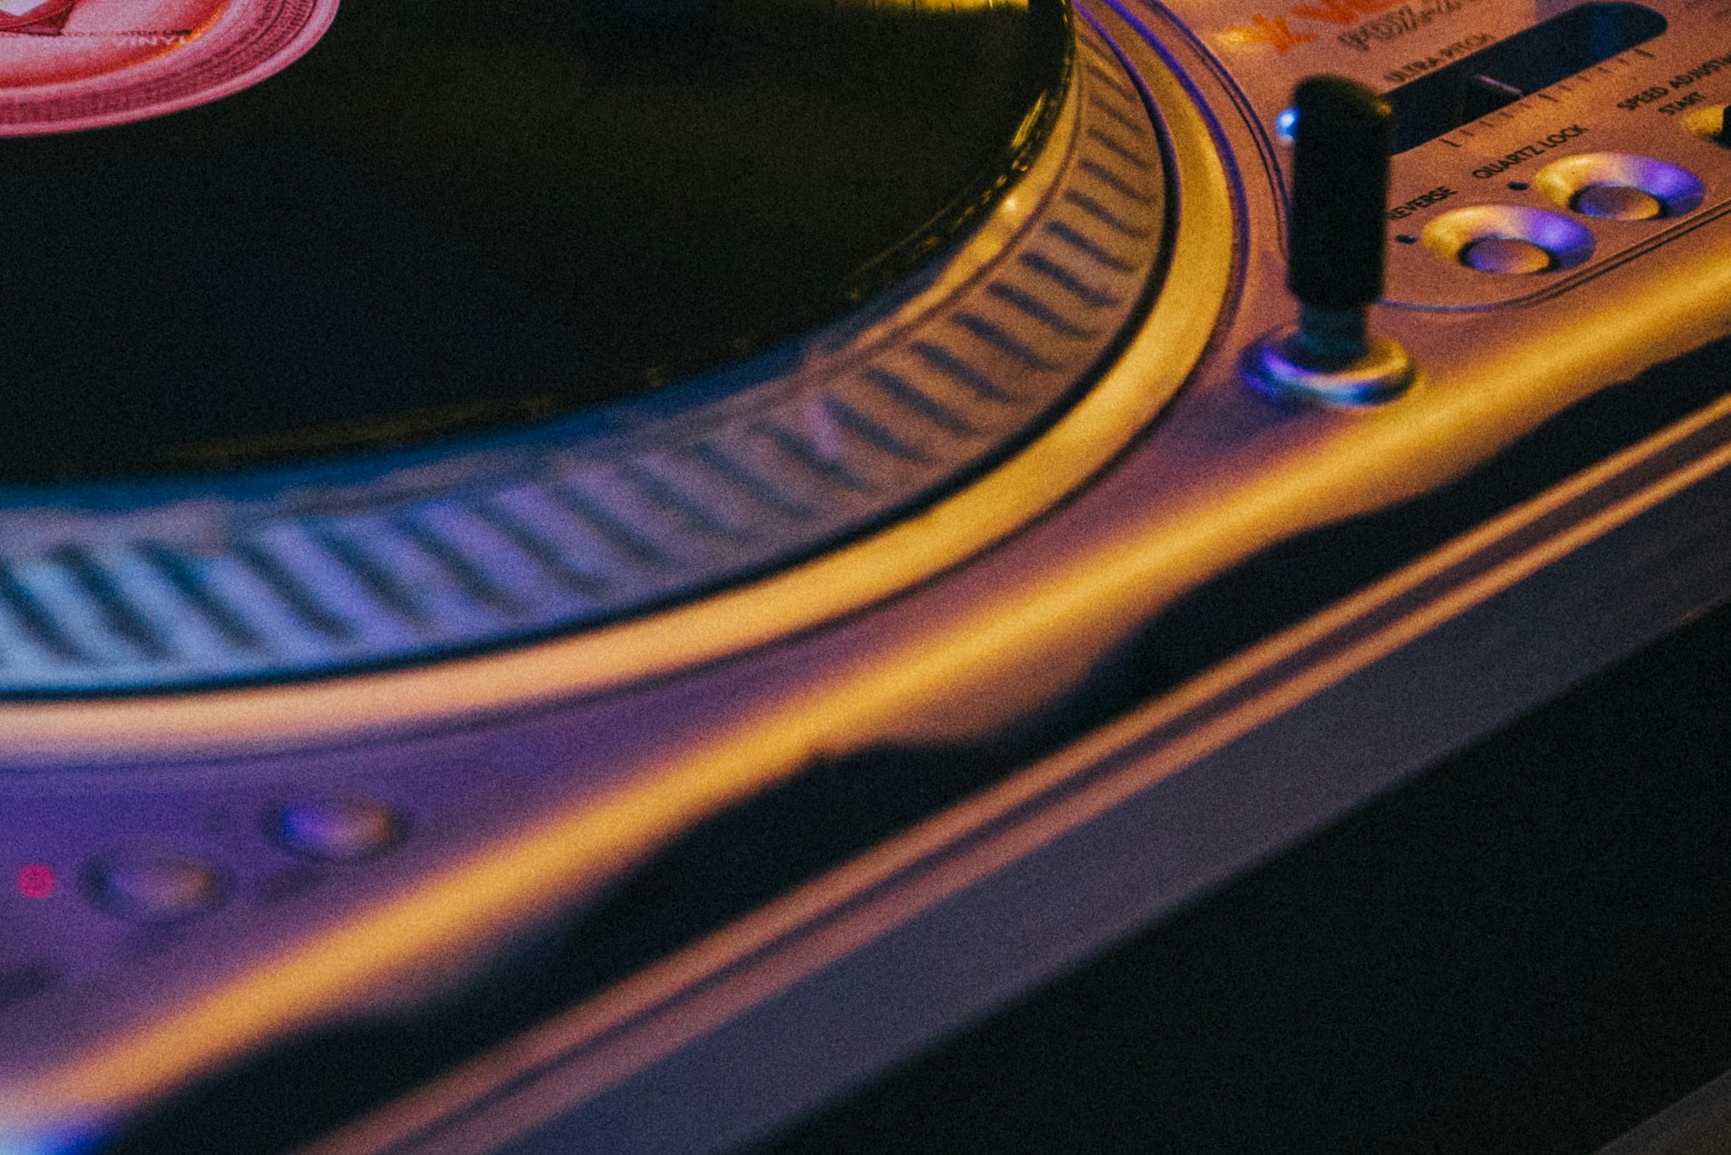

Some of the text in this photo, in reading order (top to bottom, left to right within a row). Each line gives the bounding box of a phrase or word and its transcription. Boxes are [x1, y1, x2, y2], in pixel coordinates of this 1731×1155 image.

[1617, 86, 1669, 111] SPEED
[1659, 91, 1705, 115] START
[1471, 124, 1589, 180] QUARTZ LOCK
